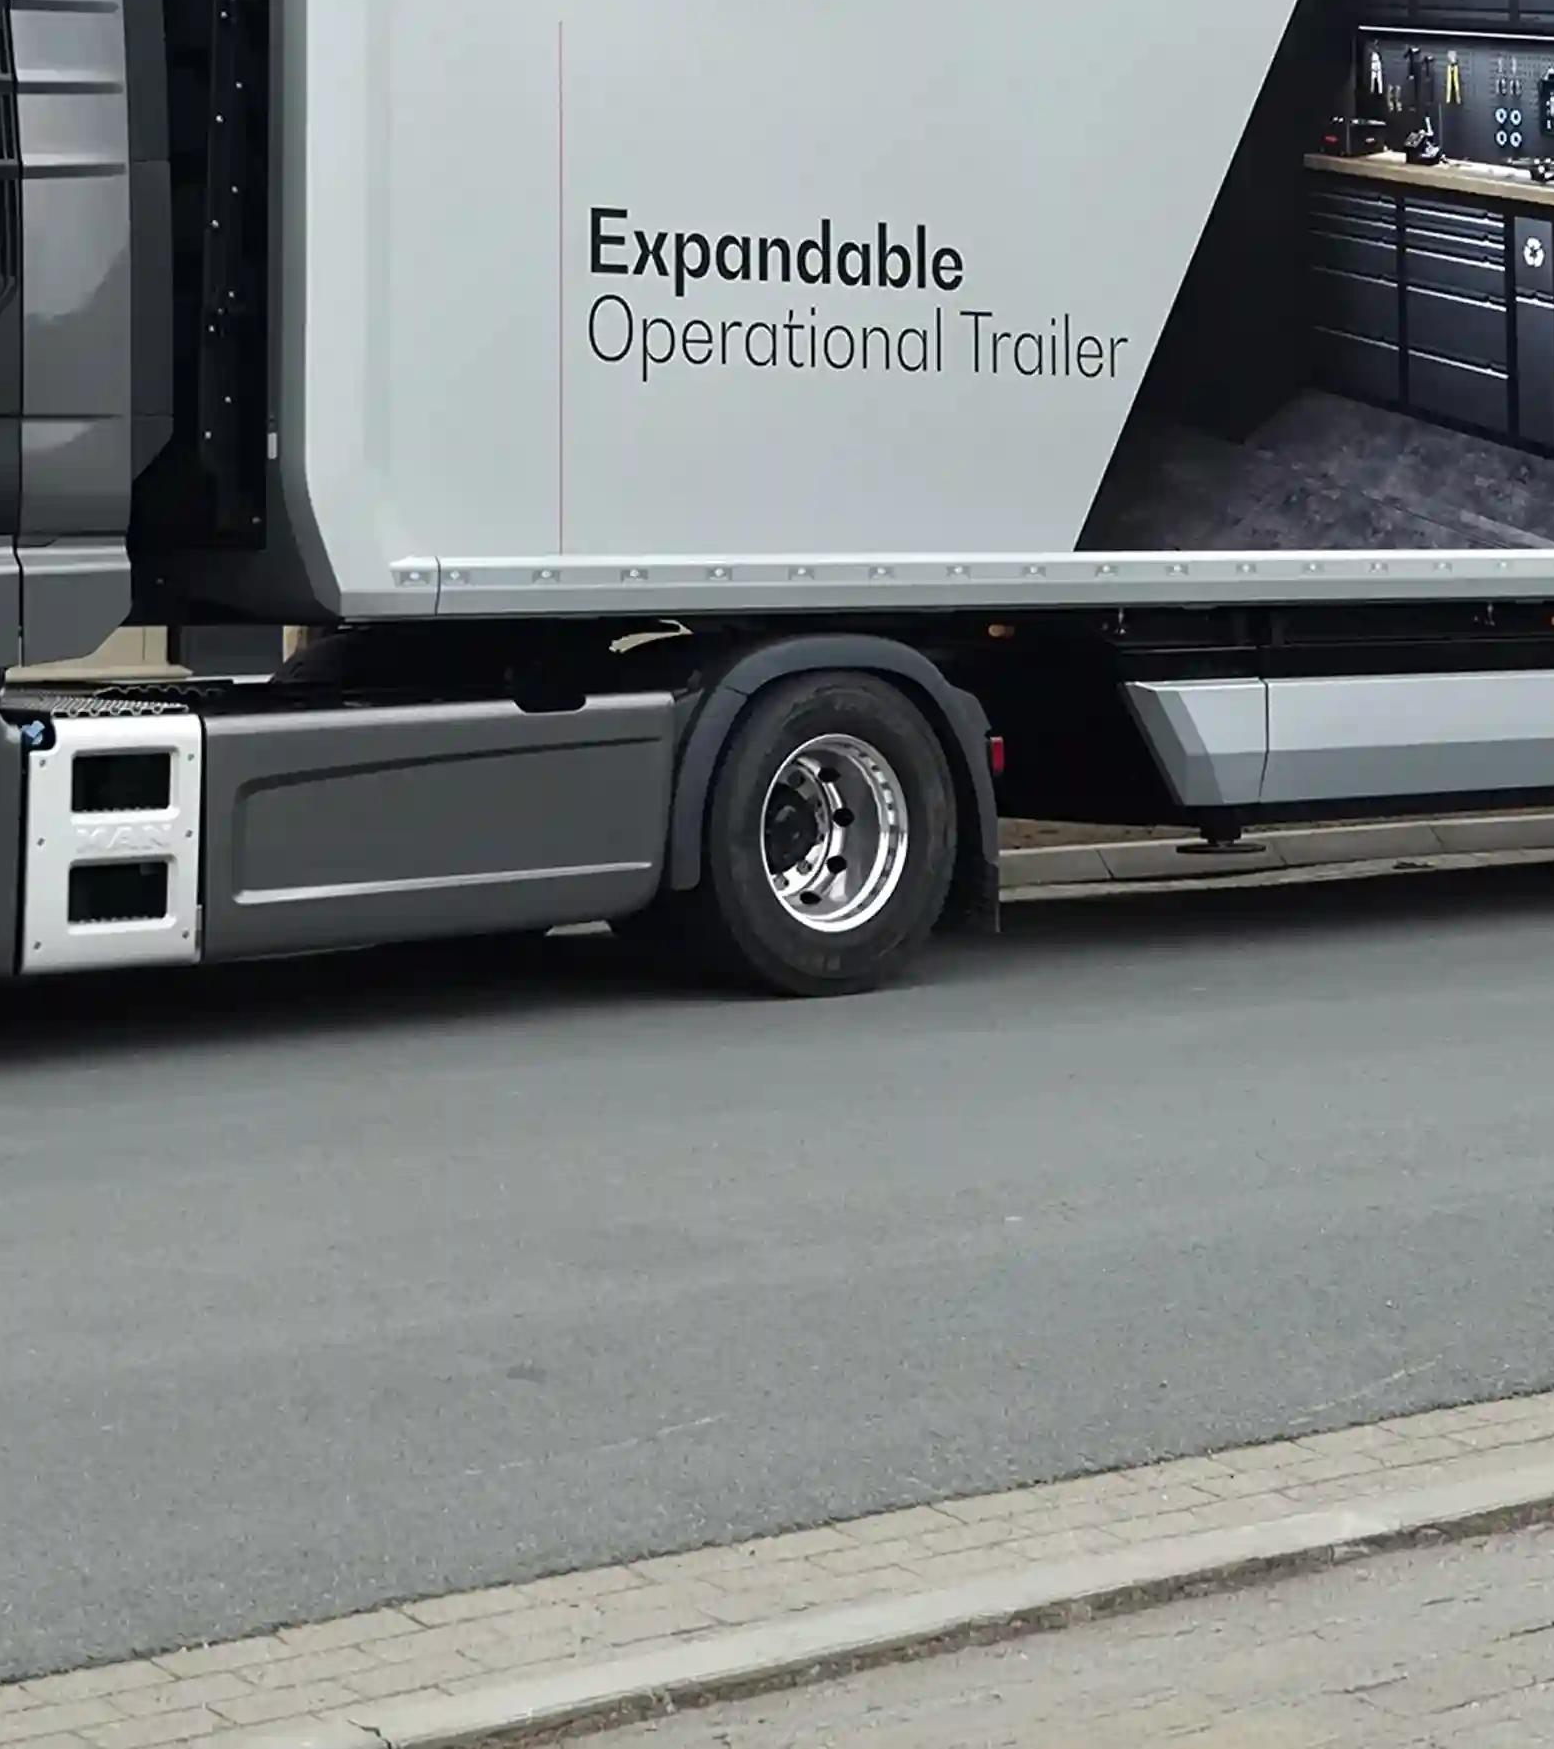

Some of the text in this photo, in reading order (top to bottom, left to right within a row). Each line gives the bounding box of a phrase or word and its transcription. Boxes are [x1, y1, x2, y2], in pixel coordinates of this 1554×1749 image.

[590, 207, 964, 298] Expandable
[588, 294, 1129, 383] Operational Trailer
[76, 823, 172, 853] MAN
